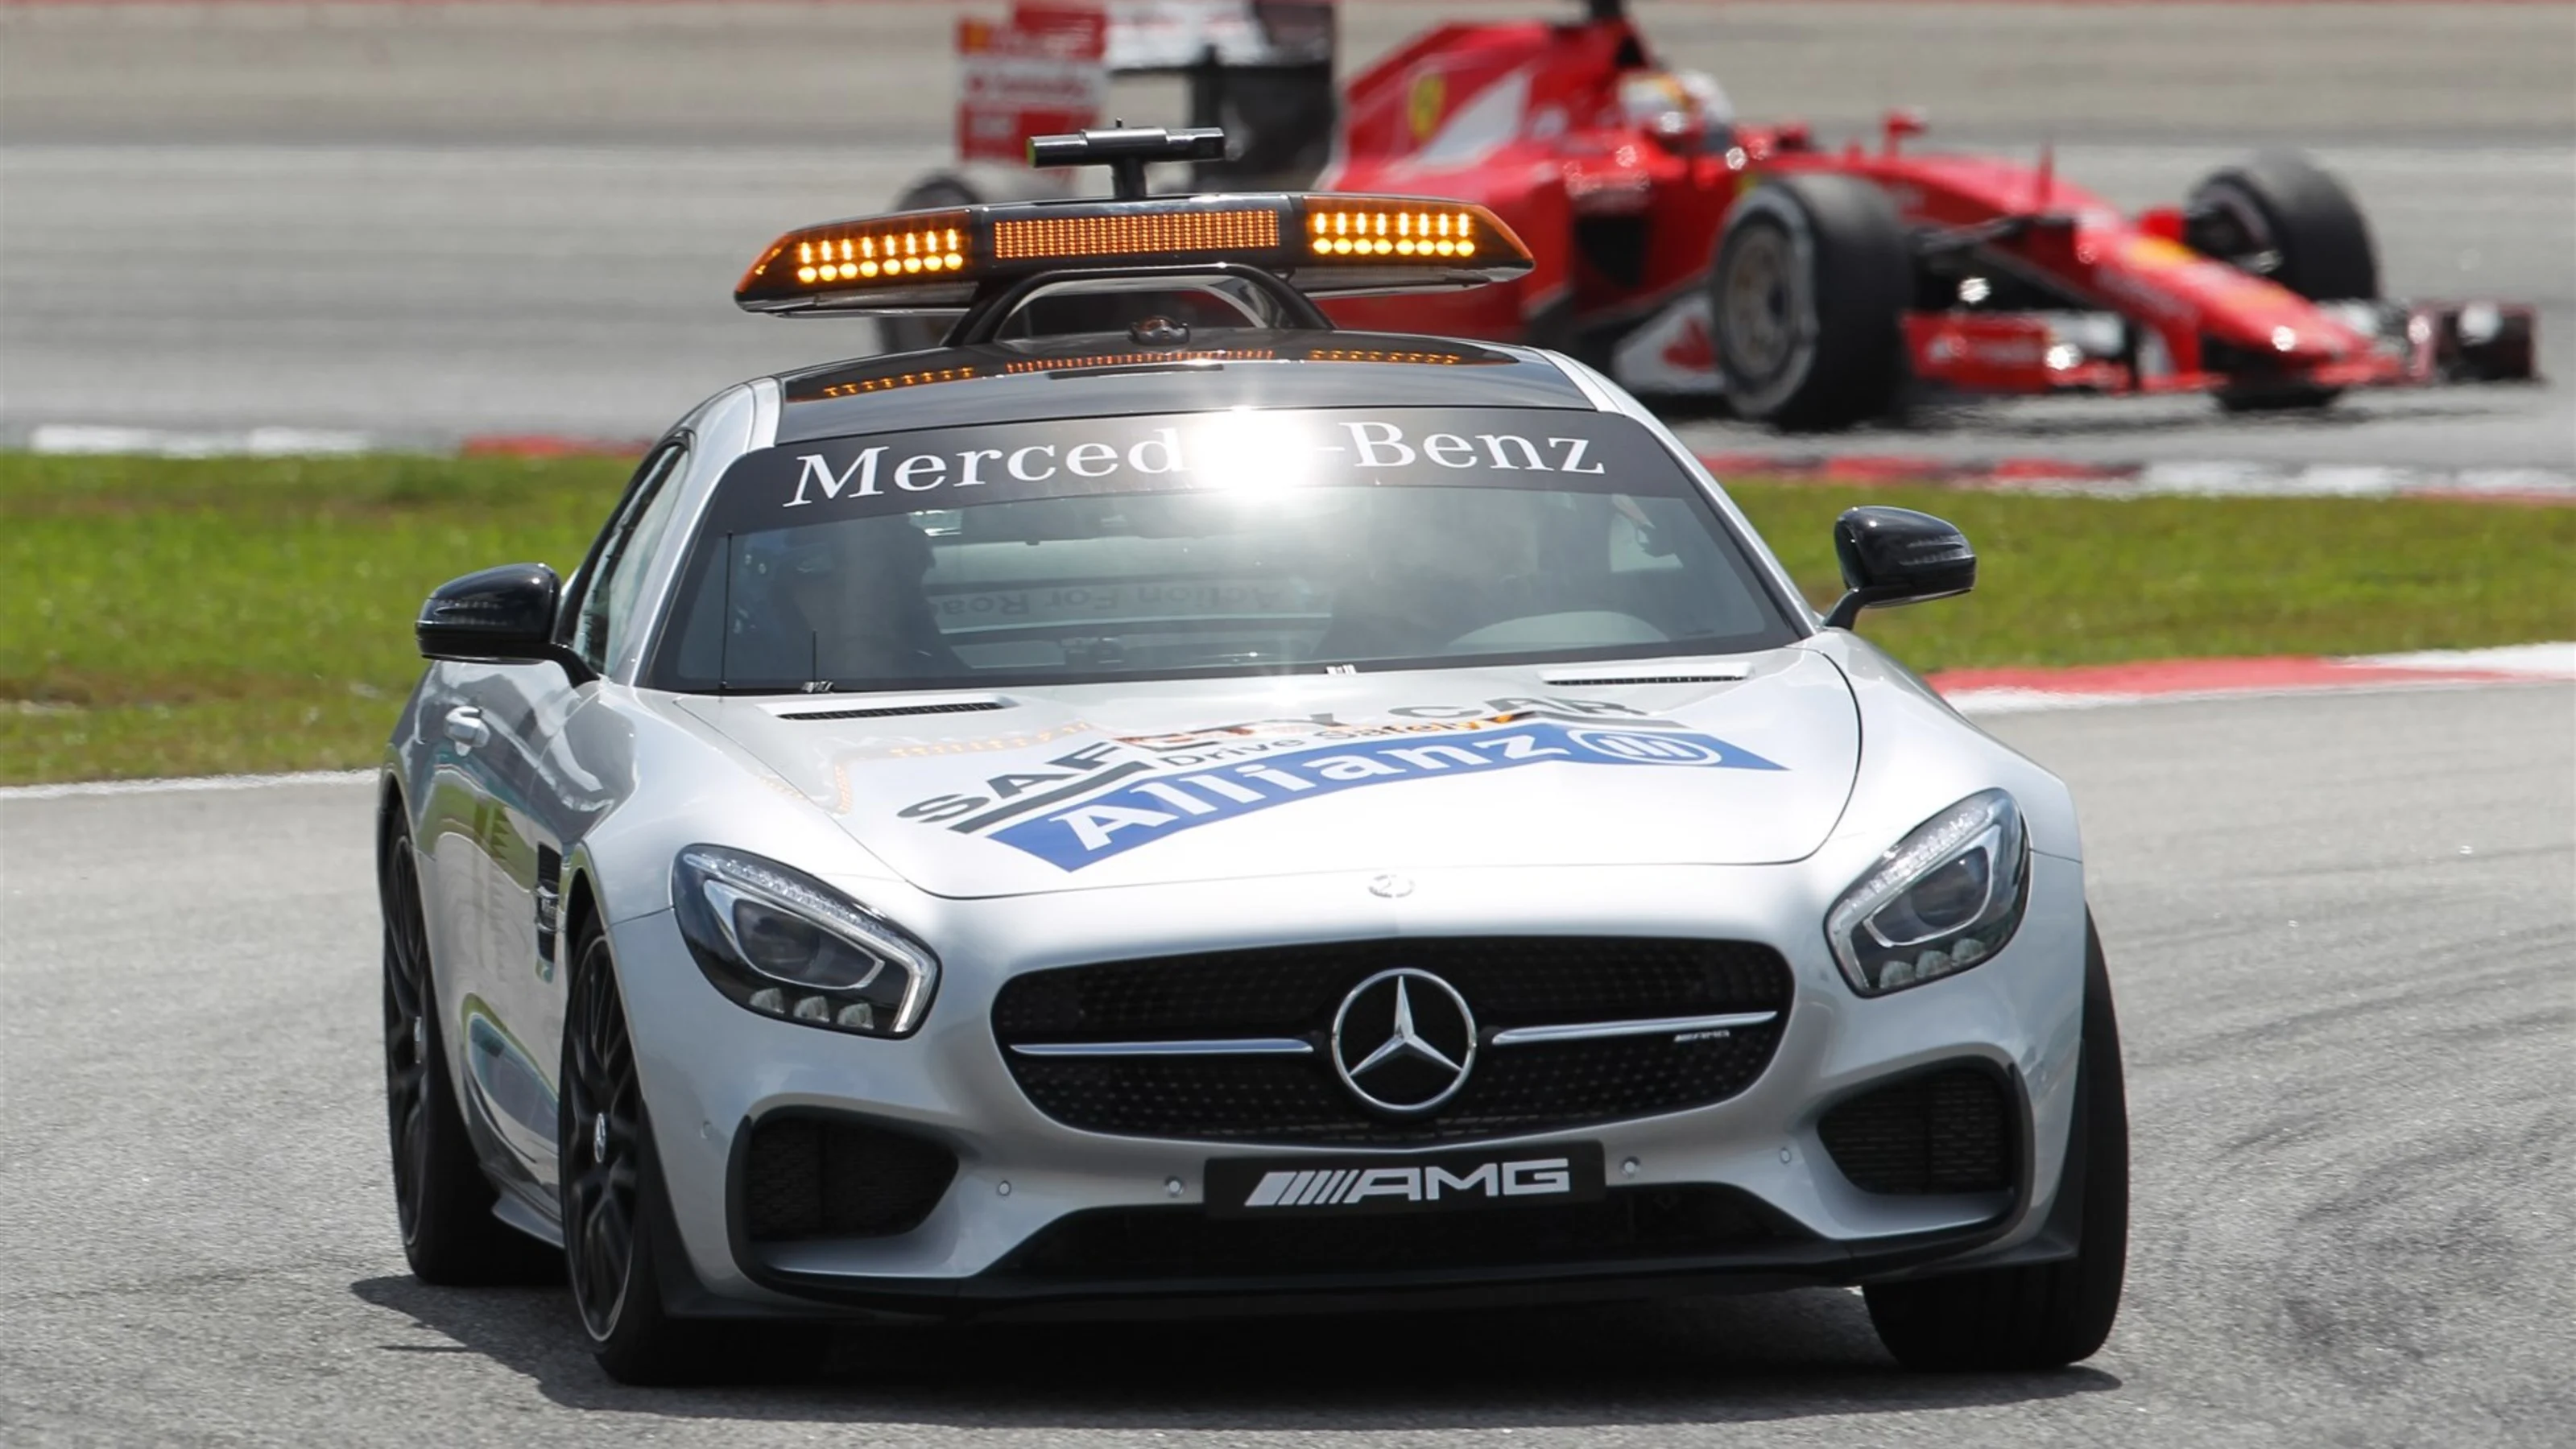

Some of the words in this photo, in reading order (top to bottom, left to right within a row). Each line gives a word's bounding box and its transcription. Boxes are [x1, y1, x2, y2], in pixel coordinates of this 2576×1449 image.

[783, 420, 1606, 508] Merced-Benz
[939, 592, 1029, 617] Roa
[1044, 588, 1121, 611] For
[1387, 696, 1649, 719] CAR
[1156, 737, 1306, 767] Drive
[1048, 733, 1572, 852] Allianz
